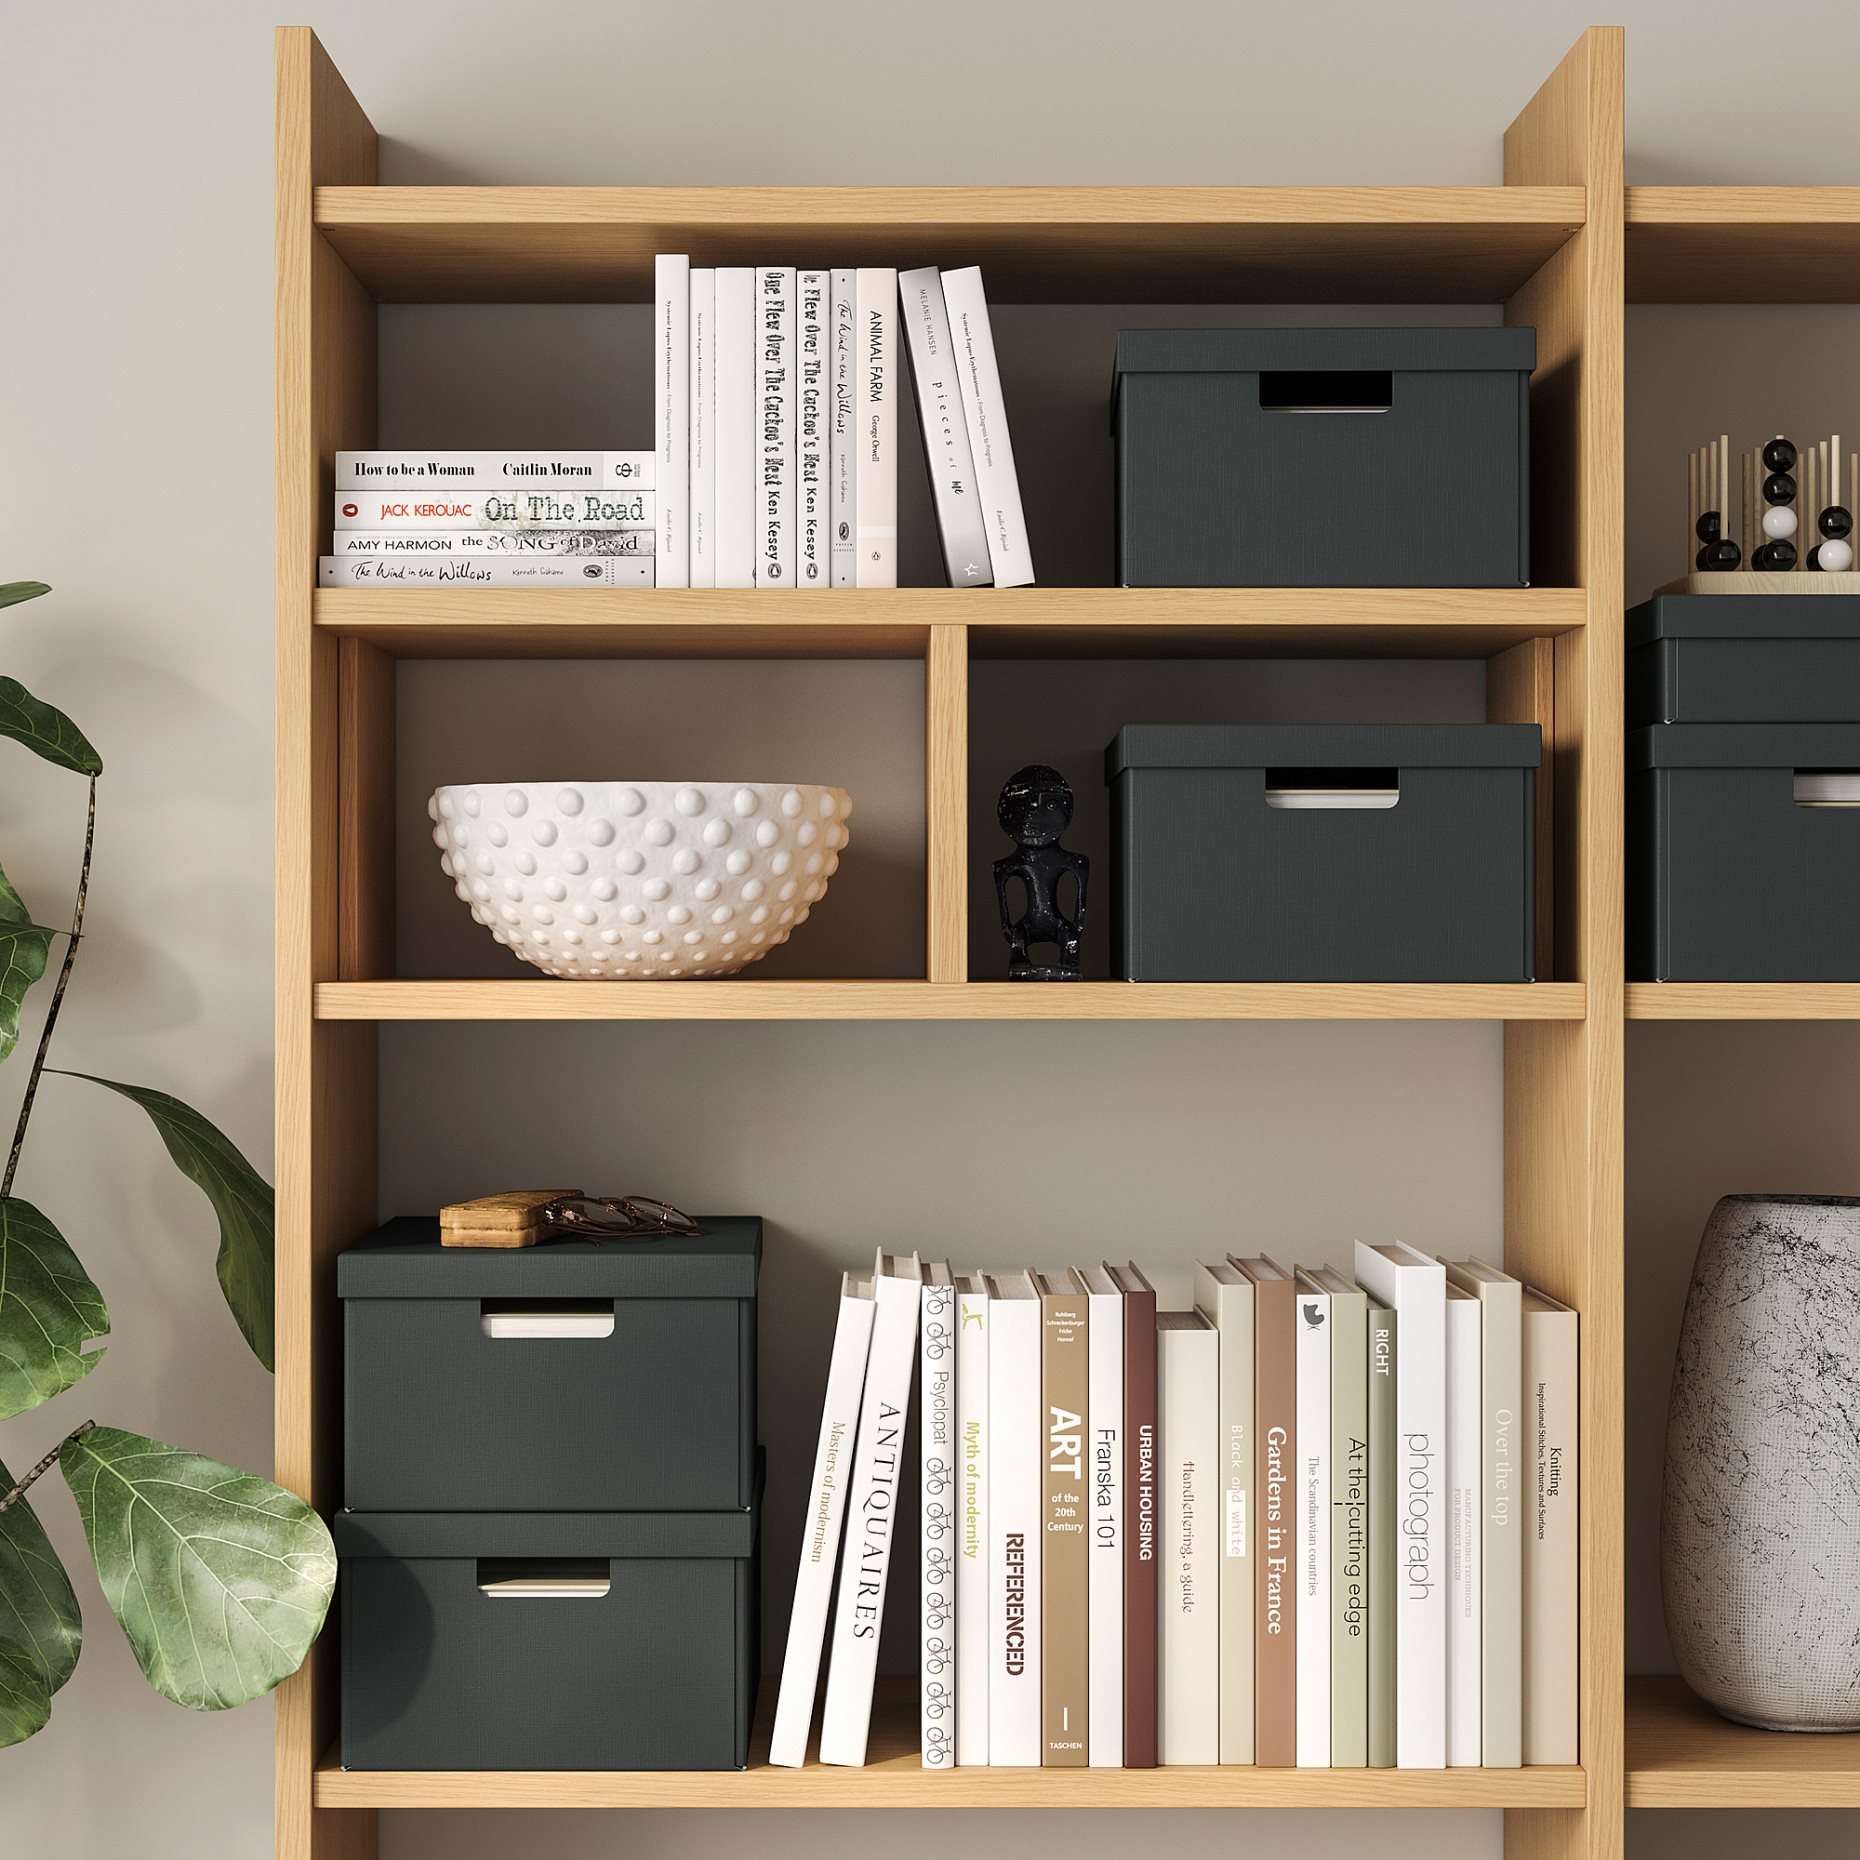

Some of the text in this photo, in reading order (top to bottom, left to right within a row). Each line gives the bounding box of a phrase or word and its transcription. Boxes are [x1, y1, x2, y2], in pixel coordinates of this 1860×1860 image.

[805, 289, 820, 320] Flew
[838, 300, 852, 320] The
[804, 325, 821, 355] Over
[838, 324, 851, 351] Wind
[804, 360, 821, 384] The
[840, 365, 848, 379] the
[870, 311, 883, 461] ANIMAL FARM George Orwell
[920, 289, 931, 321] MELANIE
[926, 325, 936, 355] HANSEN
[932, 382, 952, 445] pieces
[948, 457, 958, 468] of
[764, 273, 785, 560] One Flew Over The Cuckoo's Nest Ken Kesey
[804, 389, 819, 448] Cuckoo's
[837, 384, 852, 433] Willows
[355, 463, 591, 475] How to be a Woman Caitlin Moran
[804, 454, 820, 482] Nest
[381, 504, 472, 520] JACK KEROUAC
[485, 496, 645, 521] On The Road
[807, 488, 817, 512] Ken
[348, 540, 451, 550] AMY HARMON
[462, 535, 639, 551] the SONG of David
[804, 520, 817, 560] Kesey
[351, 561, 491, 580] The Wind in the Willows
[1374, 1328, 1389, 1377] RIGHT
[930, 1372, 949, 1445] Psyclopat
[1050, 1406, 1081, 1479] ART
[1491, 1409, 1512, 1525] Over the top
[1536, 1383, 1547, 1540] Inspirational Stitches, Textures and Surfaces
[809, 1420, 846, 1562] Masters of modernism
[963, 1422, 980, 1558] Myth of modernity
[1097, 1430, 1115, 1548] Franska 101
[1140, 1425, 1152, 1560] URBAN HOUSING
[1230, 1425, 1244, 1555] Black and white
[1547, 1448, 1561, 1496] Knitting
[853, 1402, 901, 1639] ANTIQUAIRES
[1052, 1493, 1079, 1502] of the
[1055, 1507, 1075, 1517] 20th
[1403, 1434, 1435, 1599] photograph
[1048, 1522, 1083, 1533] Century
[1267, 1427, 1286, 1634] Gardens in France
[1308, 1456, 1319, 1595] The Scandinavian countries
[1344, 1437, 1368, 1637] At the cutting edge
[1454, 1487, 1463, 1580] FOR PRODUCT DESIGN
[1463, 1489, 1472, 1562] MANUFACTURING
[1006, 1534, 1024, 1675] REFERENCED
[1180, 1575, 1194, 1613] guide
